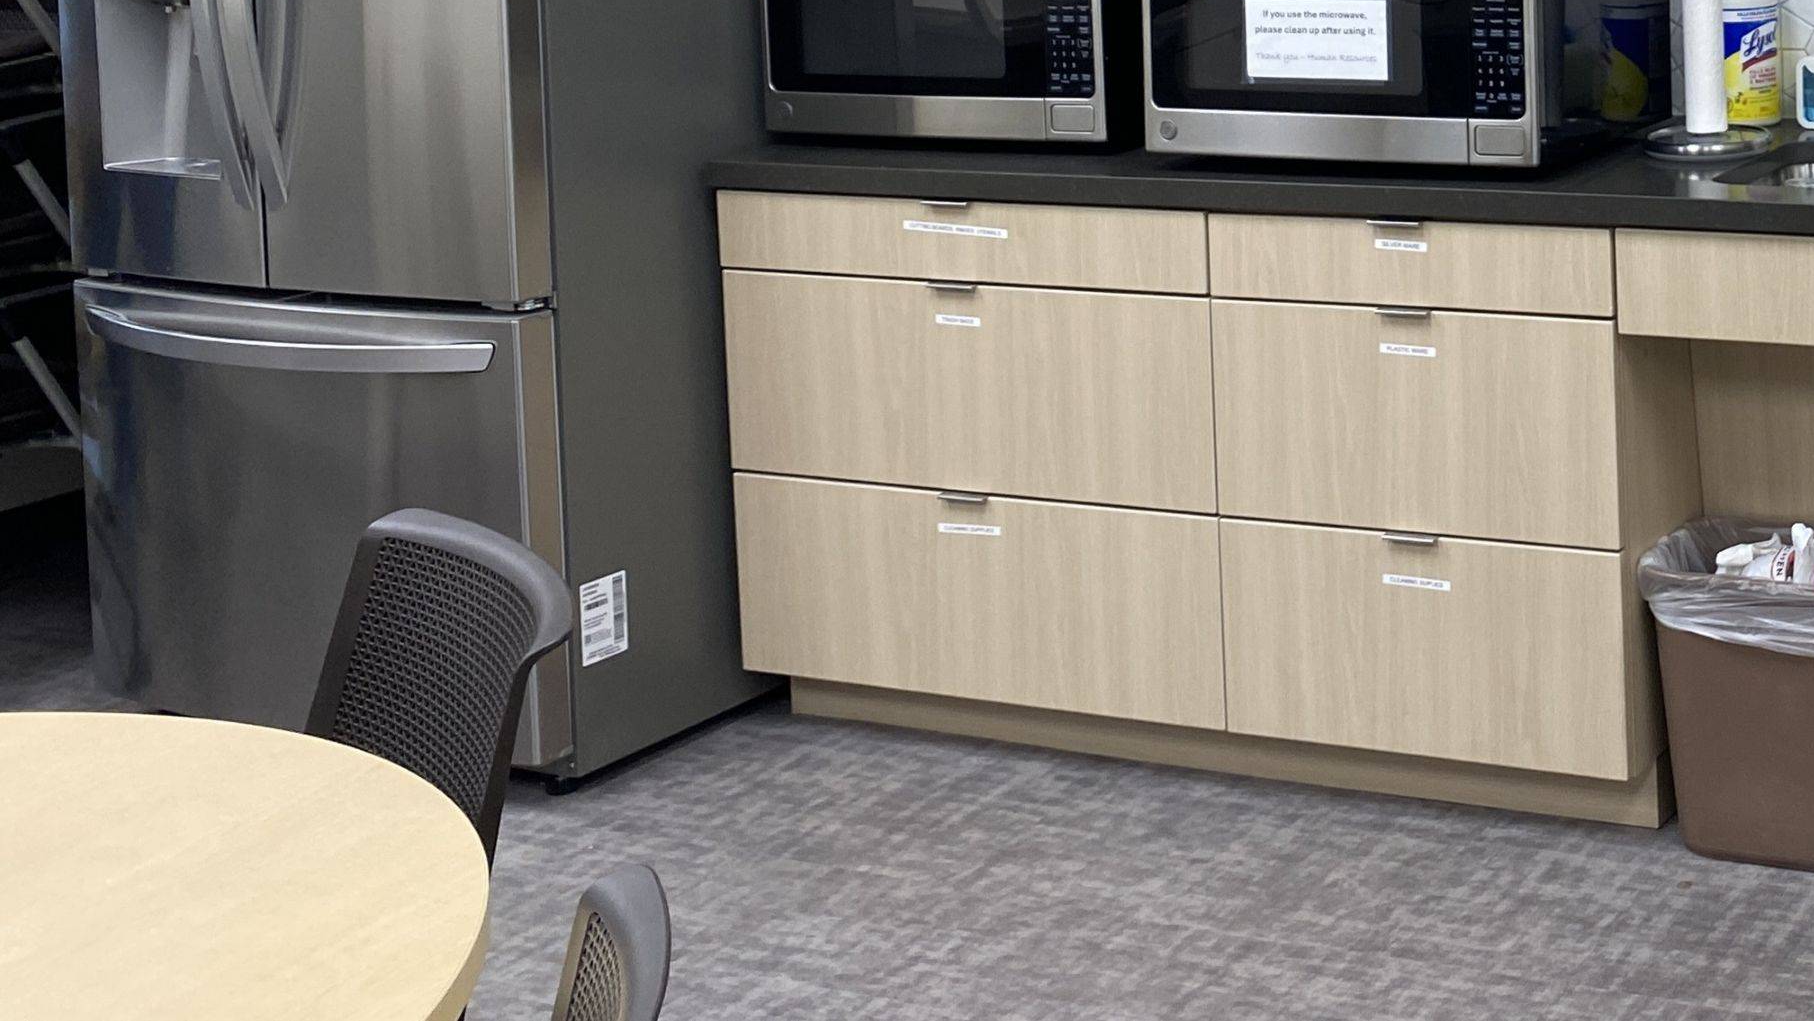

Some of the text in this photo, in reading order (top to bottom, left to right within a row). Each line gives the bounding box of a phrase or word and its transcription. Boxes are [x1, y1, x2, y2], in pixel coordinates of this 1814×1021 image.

[1262, 10, 1269, 18] If
[1270, 11, 1285, 19] you
[1303, 10, 1318, 19] the
[1319, 11, 1367, 20] microwave,
[1255, 25, 1282, 35] please
[1284, 26, 1308, 34] clean
[1309, 27, 1320, 36] up
[1343, 27, 1366, 37] using
